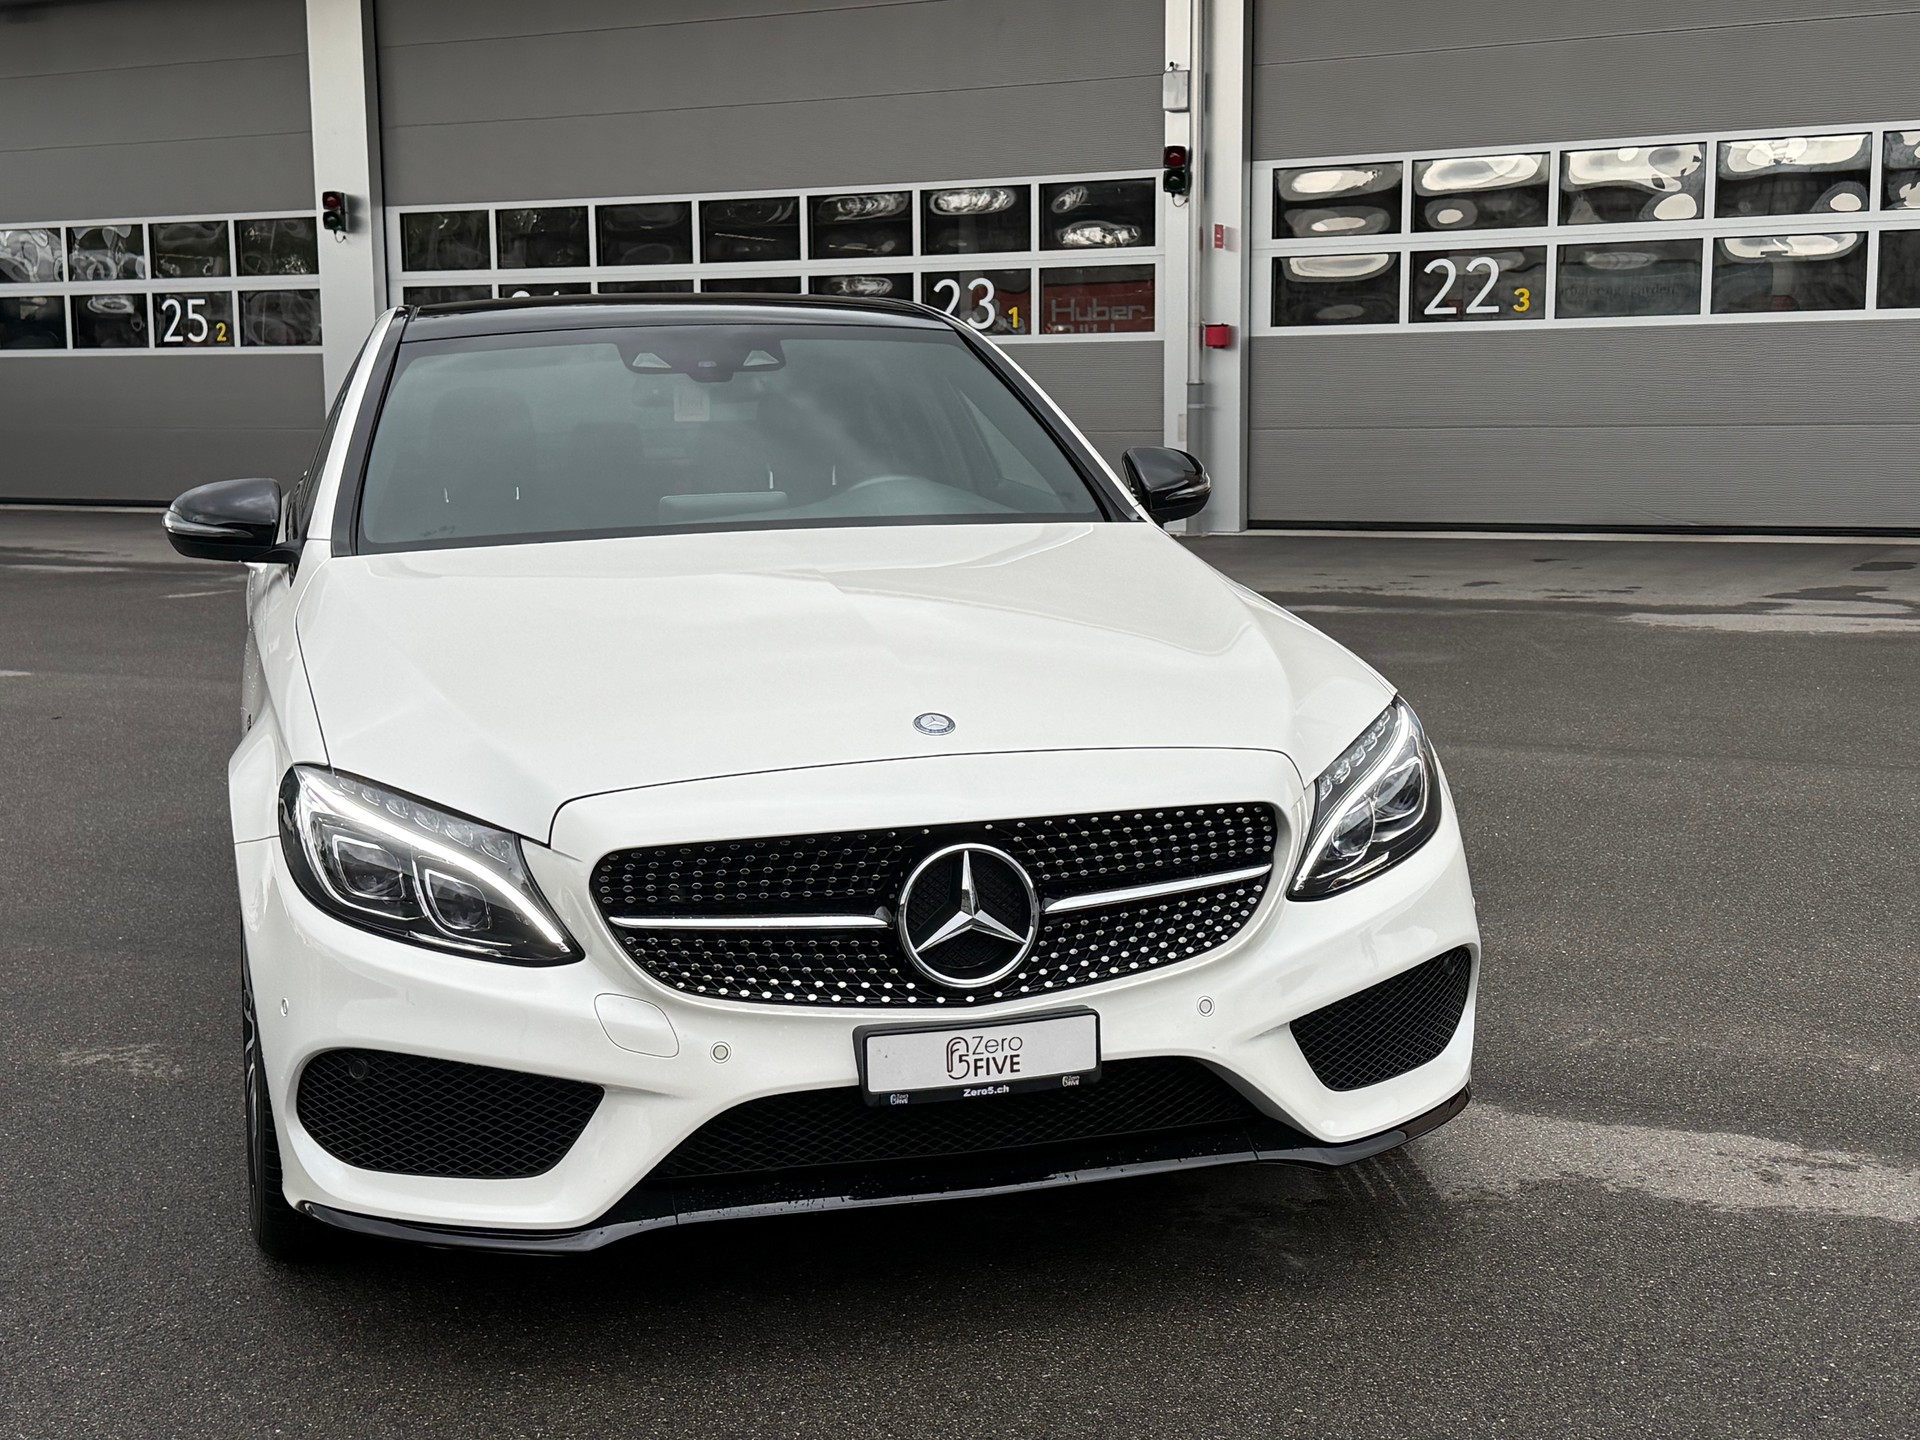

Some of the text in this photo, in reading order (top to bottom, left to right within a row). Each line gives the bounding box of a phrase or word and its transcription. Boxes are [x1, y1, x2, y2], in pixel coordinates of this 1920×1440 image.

[1423, 256, 1531, 315] 22 3
[933, 277, 1019, 330] 23 1
[1051, 297, 1146, 322] Huber
[161, 298, 227, 343] 25 2
[972, 1035, 1023, 1055] Zero
[973, 1054, 1021, 1077] FIVE
[963, 1084, 1010, 1097] Zero5.ch
